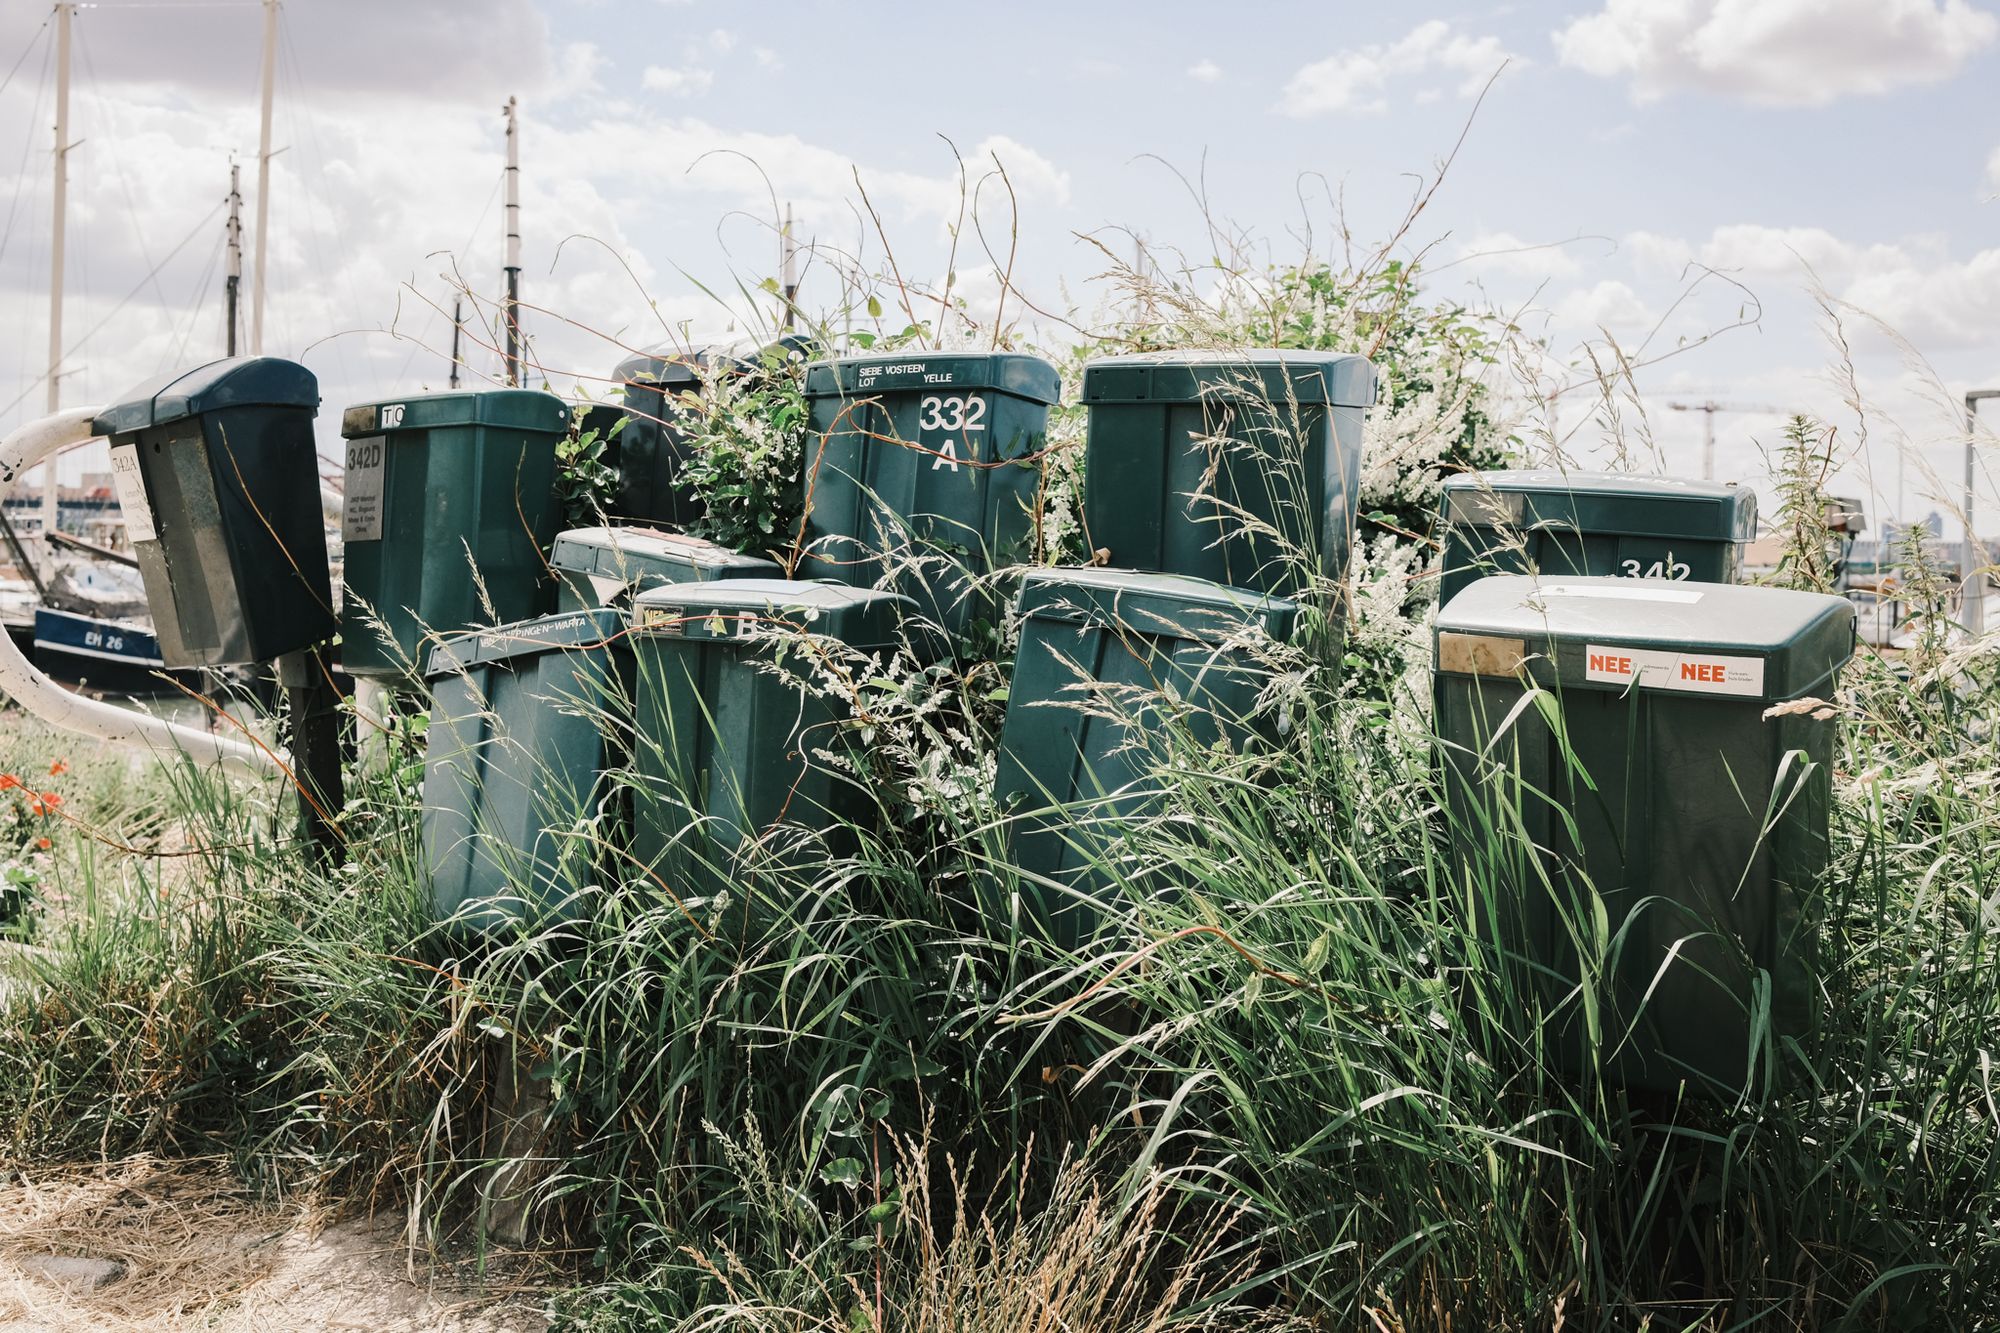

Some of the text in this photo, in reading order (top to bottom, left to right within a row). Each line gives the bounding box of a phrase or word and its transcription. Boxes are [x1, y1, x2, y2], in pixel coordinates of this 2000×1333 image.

[858, 373, 952, 388] LOT YELLE
[859, 363, 926, 377] SIEBE VOSTEEN
[920, 396, 986, 431] 332
[348, 445, 381, 471] 342D
[932, 439, 959, 472] A
[106, 635, 123, 650] 26
[1590, 654, 1632, 675] NEE
[1681, 662, 1726, 683] NEE
